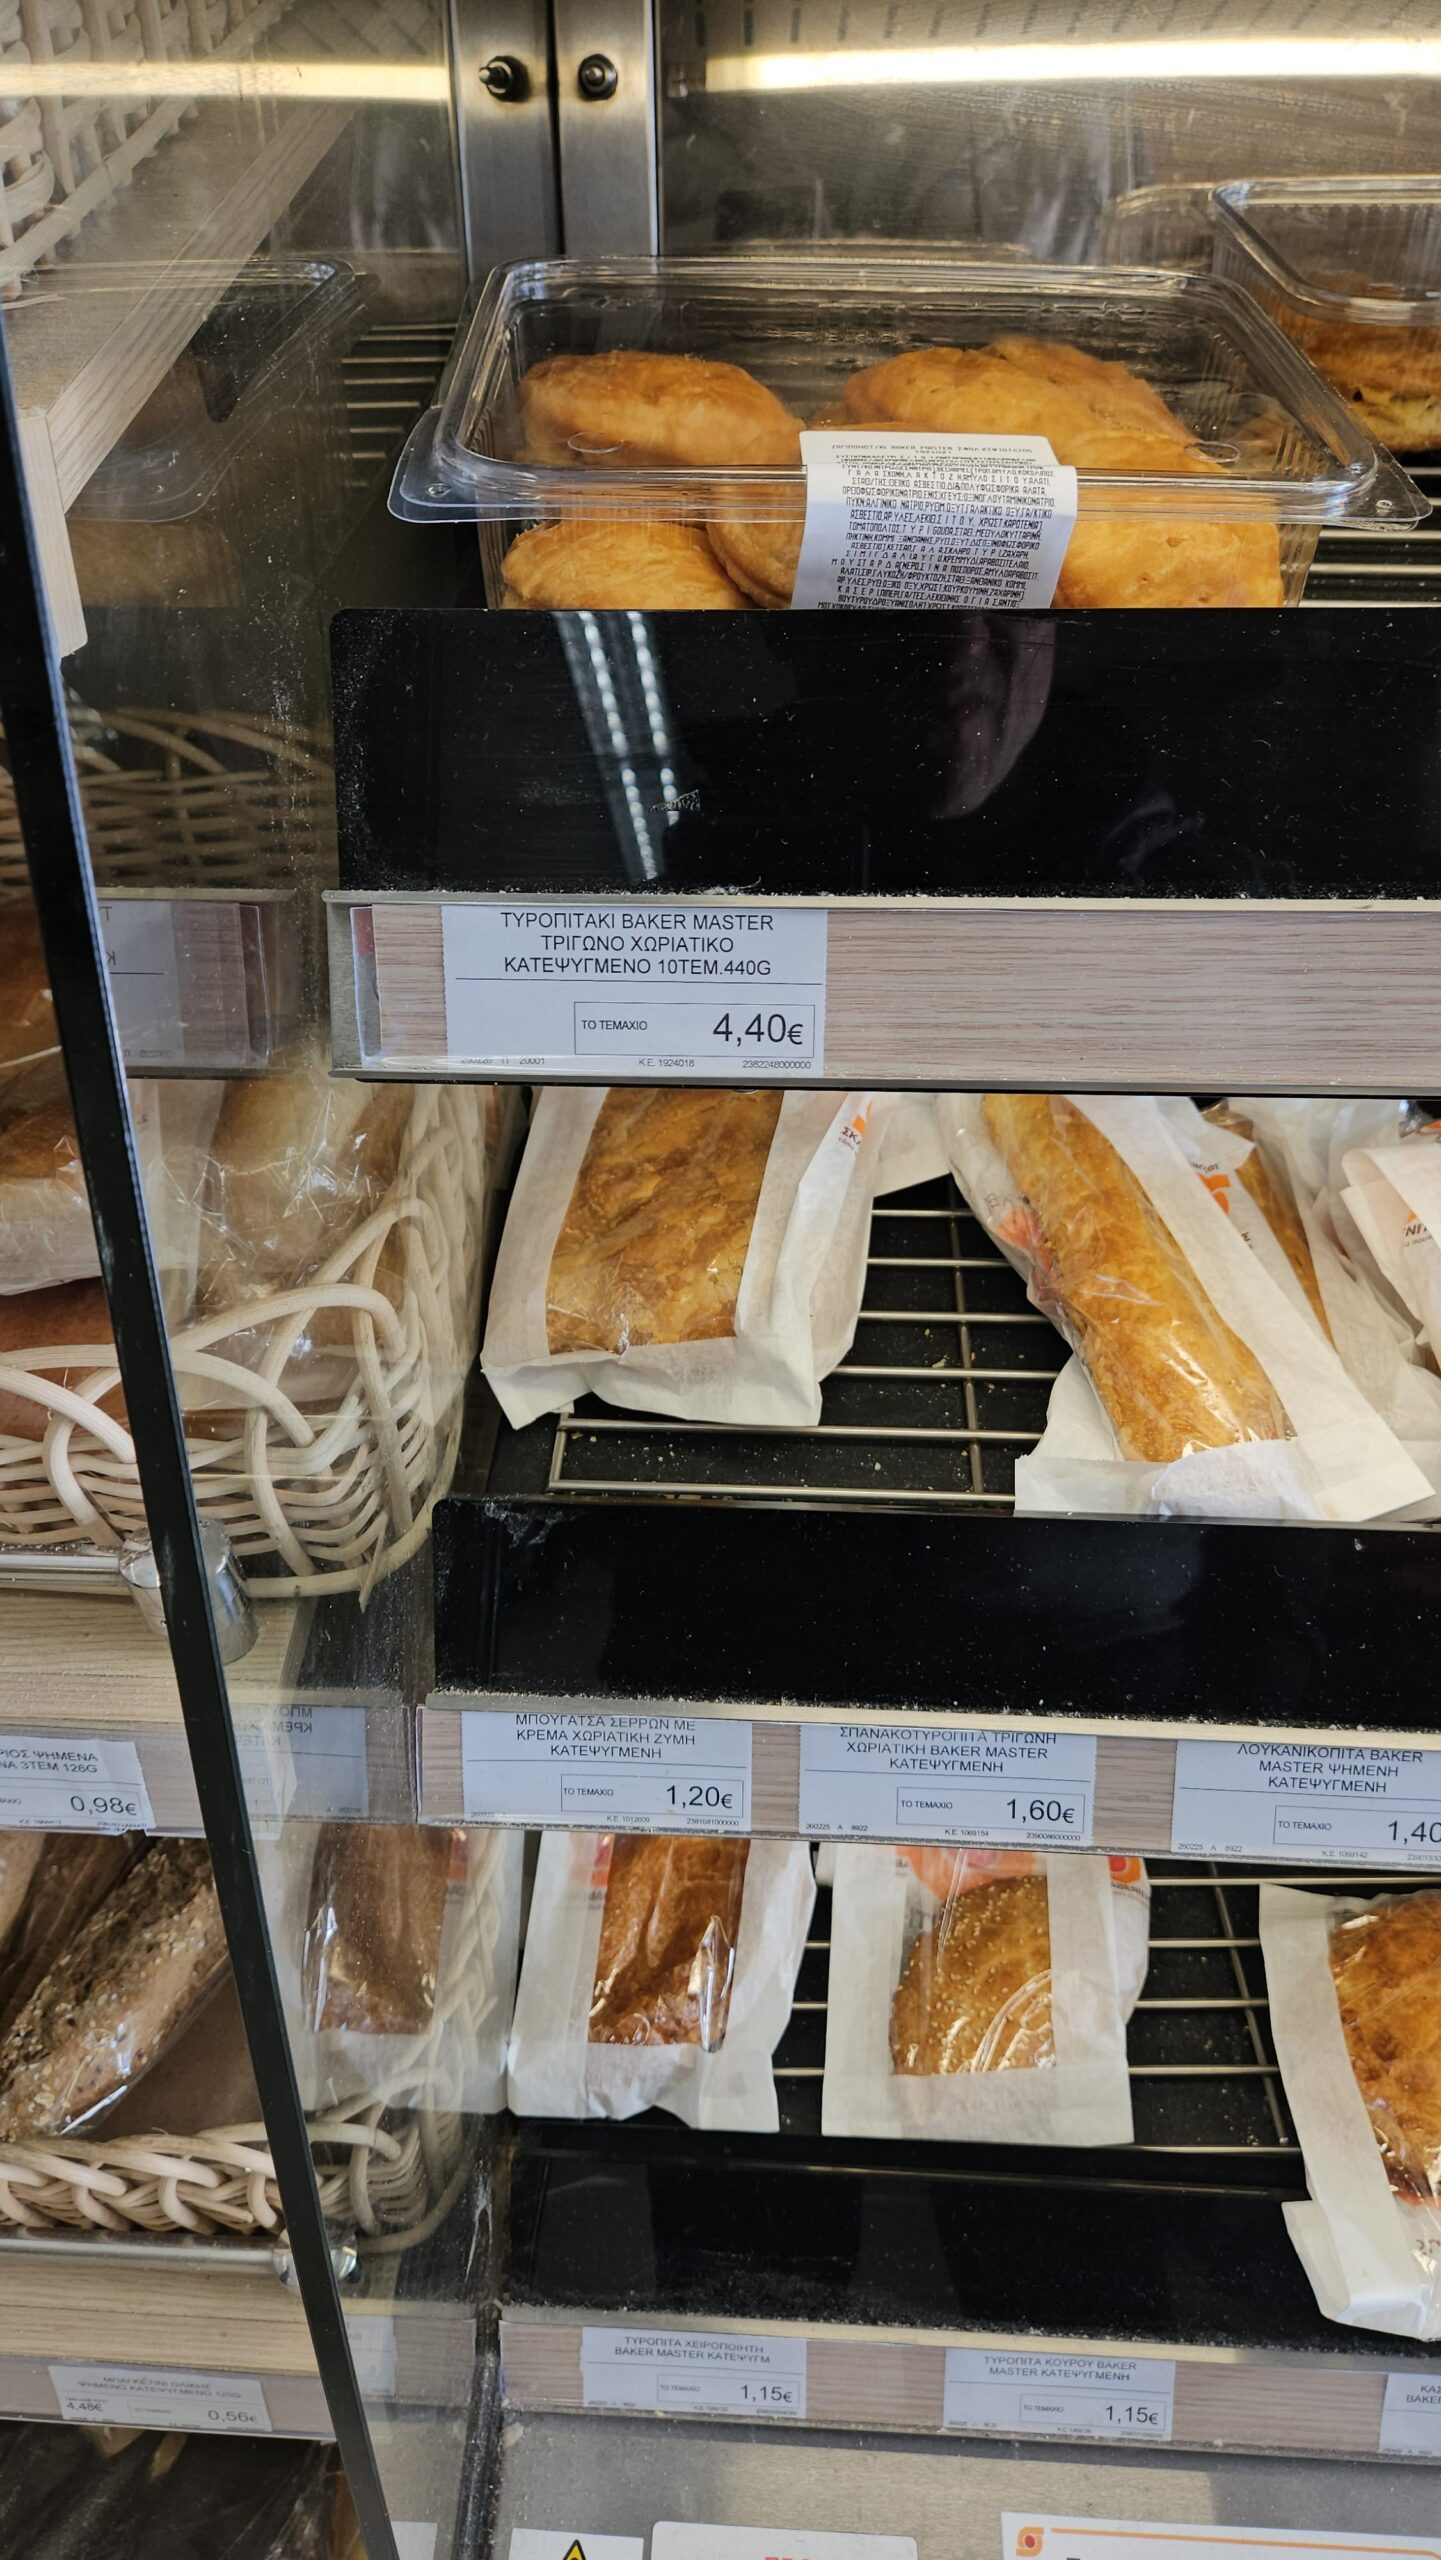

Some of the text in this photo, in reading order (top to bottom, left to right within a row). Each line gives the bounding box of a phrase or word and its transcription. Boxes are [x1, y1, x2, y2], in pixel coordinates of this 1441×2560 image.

[501, 912, 774, 931] ΤΥΡΟΠΙΤΑΚΙ BAKER MASTER
[541, 935, 734, 953] ΤΡΙΓΩΝΟ ΧΩΡΙΑΤΙΚΟ
[504, 956, 771, 976] ΚΑΤΕΨΥΓΜΕΝΟ 10ΤΕΜ.440G
[581, 1020, 648, 1031] ΤΟ ΤΕΜΑΧΙΟ
[712, 1012, 804, 1047] 4,40€
[658, 1058, 695, 1067] 1924018
[515, 1714, 696, 1731] ΜΠΟΥΓΑΤΣΑ ΣΕΡΡΩΝ ΜΕ
[516, 1729, 696, 1746] ΚΡΕΜΑ ΧΩΡΙΑΤΙΚΗ ΖΥΜΗ
[840, 1726, 1057, 1745] ΣΠΑΝΑΚΟΤΥΡΟΠΙΤΑ ΤΡΙΓΩΝΗ
[32, 1751, 98, 1762] ΨΗΜΕΝΑ
[550, 1745, 662, 1760] ΚΑΤΕΨΥΓΜΕΝΗ
[846, 1742, 1048, 1760] ΧΩΡΙΑΤΙΚΗ BAKER MASTER
[1237, 1743, 1424, 1764] ΛΟΥΚΑΝΙΚΟΠΙΤΑ BAKER
[20, 1761, 60, 1771] 3ΤΕΜ
[890, 1757, 1003, 1773] ΚΑΤΕΨΥΓΜΕΝΗ
[1259, 1760, 1399, 1778] MASTER ΨΗΜΕΝΗ
[563, 1787, 615, 1797] ΤΟ ΤΕΜΑΧΙΟ
[1268, 1776, 1387, 1793] ΚΑΤΕΨΥΓΜΕΝΗ
[665, 1784, 733, 1809] 1,20€
[901, 1800, 953, 1810] ΤΟ ΤΕΜΑΧΙΟ
[70, 1795, 138, 1816] 0,98€
[1006, 1798, 1075, 1825] 1,60€
[1278, 1820, 1332, 1831] ΤΟ ΤΕΜΑΧΙΟ
[624, 2336, 765, 2353] ΤΥΡΟΠΙΤΑ ΧΕΙΡΟΠΟΙΗΤΗ
[614, 2347, 771, 2364] BAKER MASTER ΚΑΤΕΨΥΓΜ
[984, 2355, 1137, 2371] ΤΥΡΟΠΙΤΑ ΚΟΥΡΟΥ BAKER
[988, 2366, 1131, 2382] MASTER ΚΑΤΕΨΥΓΜΕΝΗ
[740, 2384, 793, 2403] 1,15€
[207, 2409, 258, 2424] 0,56€
[1104, 2405, 1158, 2425] 1,15€
